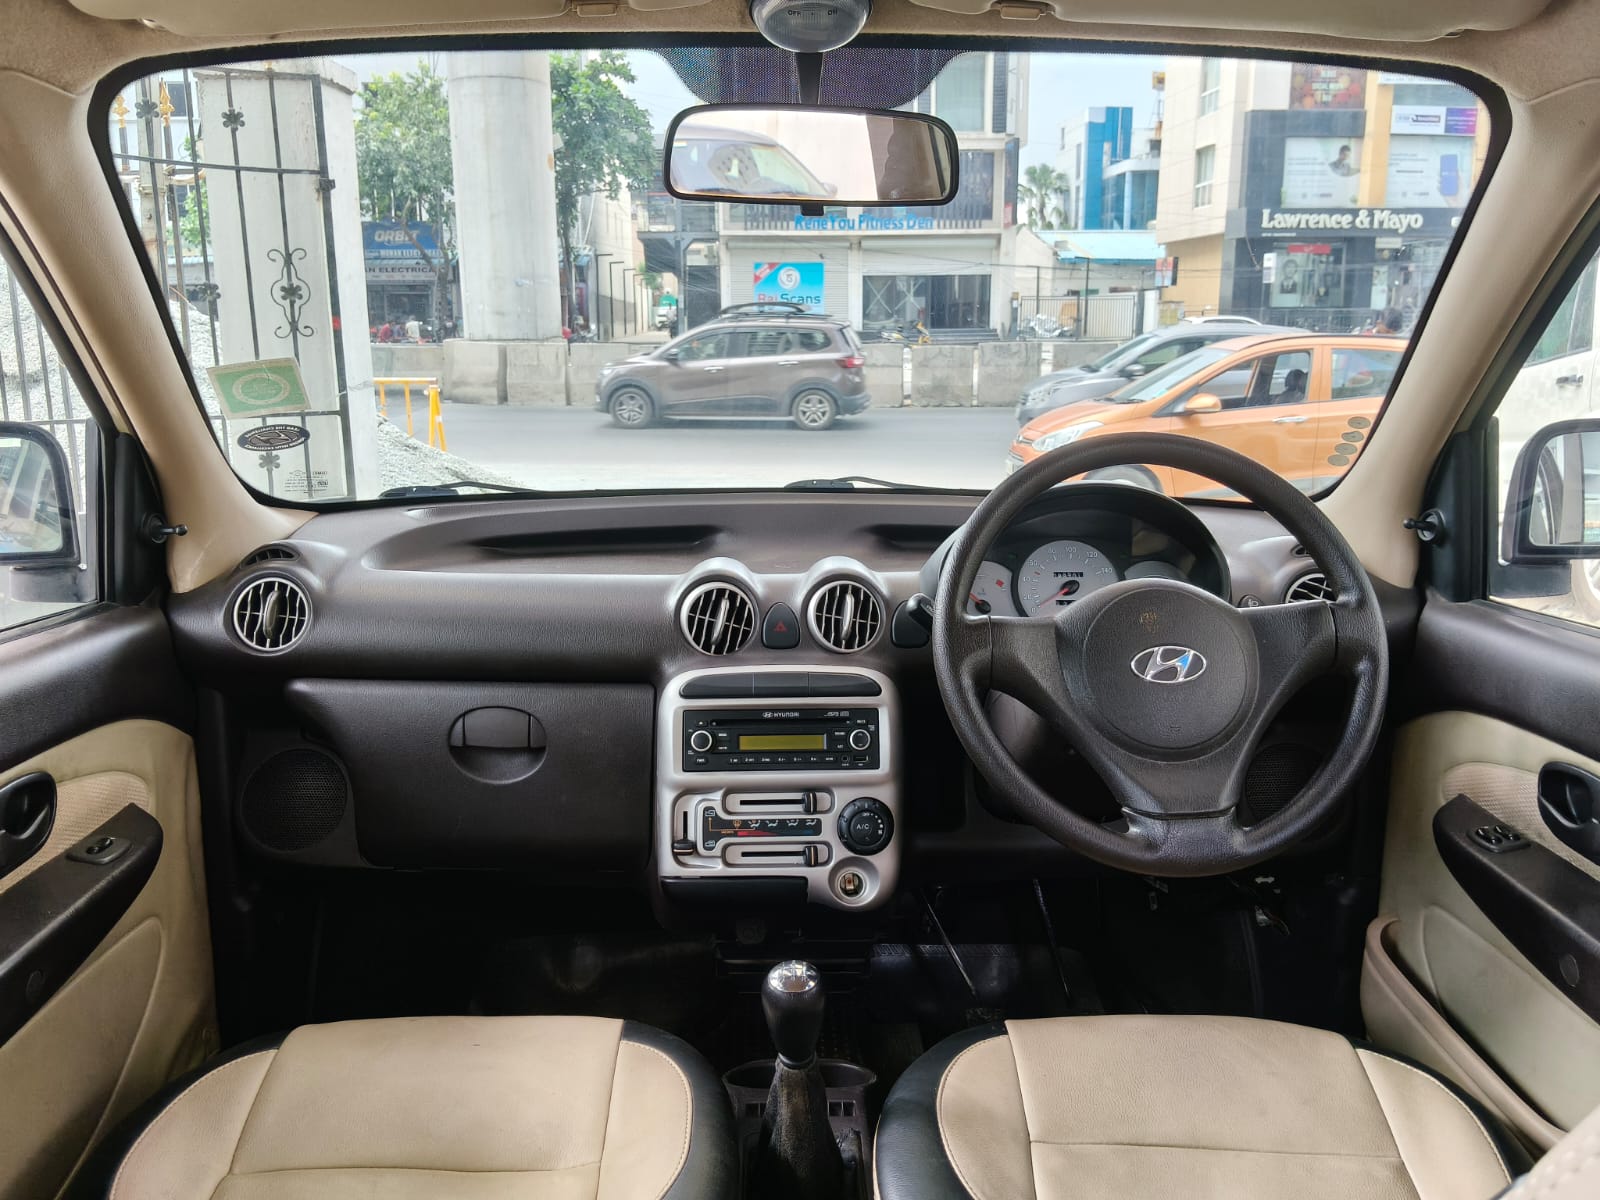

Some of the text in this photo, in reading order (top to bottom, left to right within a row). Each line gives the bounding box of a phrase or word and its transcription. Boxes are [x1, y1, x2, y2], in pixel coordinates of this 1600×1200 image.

[906, 213, 934, 230] Den
[1261, 208, 1424, 234] Lawrence & Mayo
[780, 293, 821, 304] Scans
